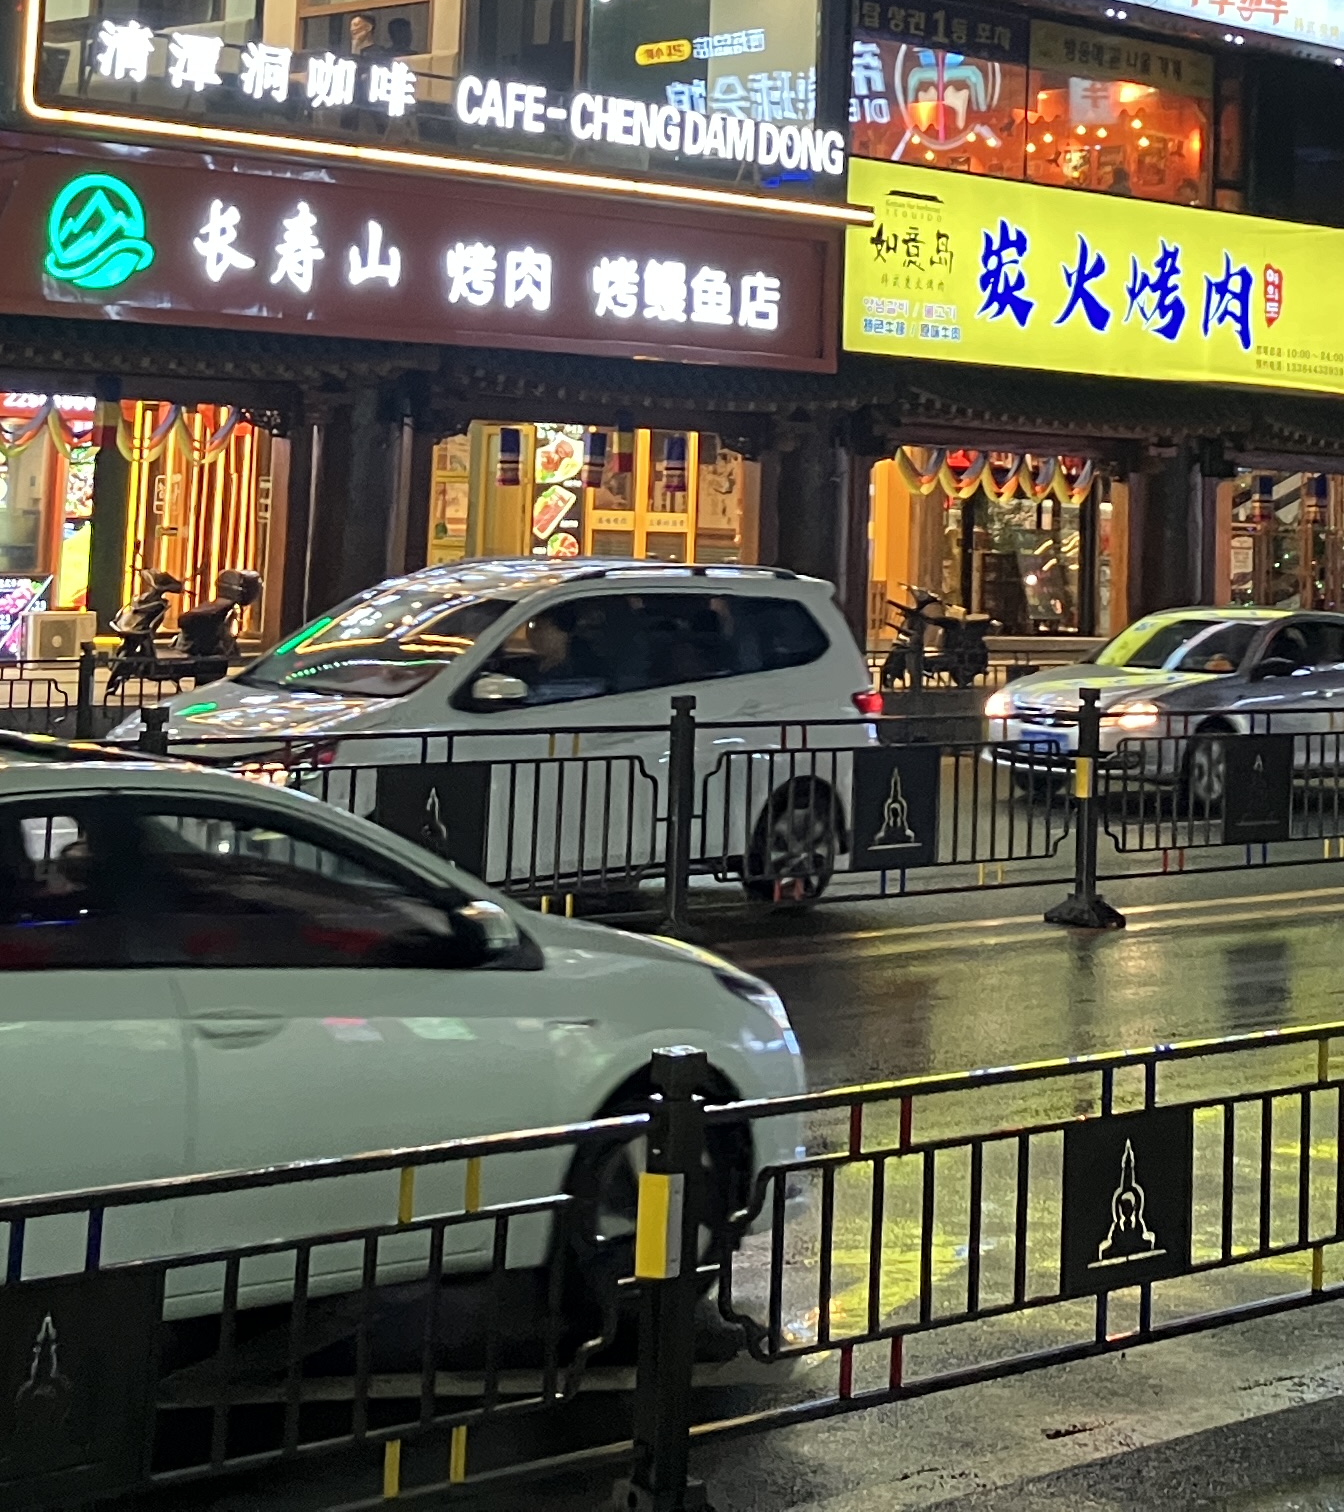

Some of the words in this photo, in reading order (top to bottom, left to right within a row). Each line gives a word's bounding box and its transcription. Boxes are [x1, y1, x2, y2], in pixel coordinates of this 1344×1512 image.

[98, 19, 417, 117] 清潭洞咖啡
[193, 198, 402, 293] 长寿山
[447, 242, 552, 312] 烤肉
[592, 256, 781, 331] 烤鳗鱼店
[870, 223, 953, 274] 如意岛
[976, 217, 1255, 351] 炭火烤肉
